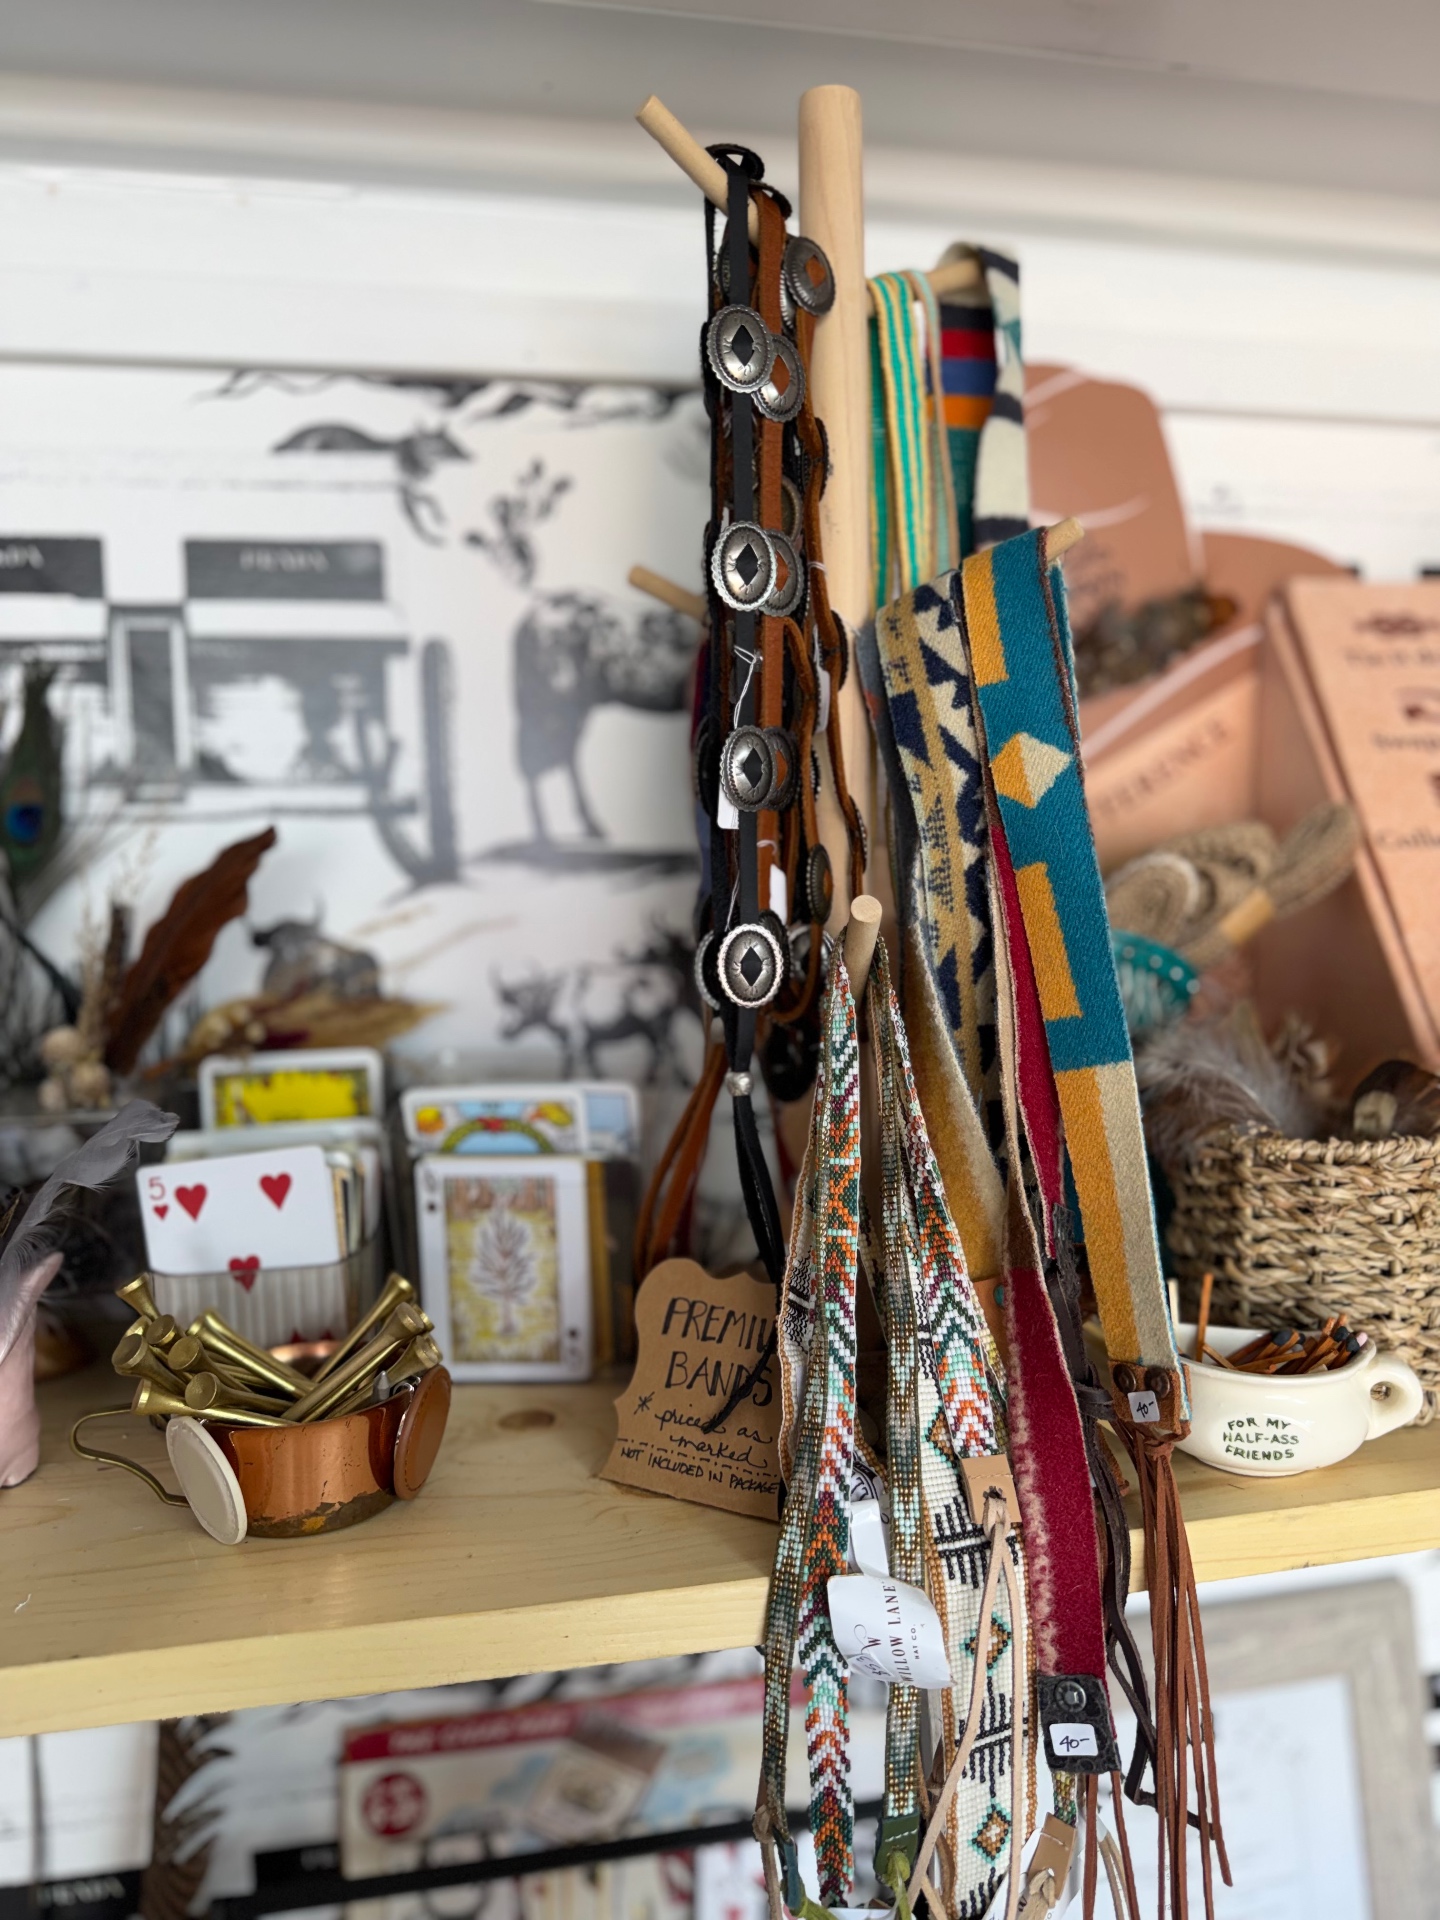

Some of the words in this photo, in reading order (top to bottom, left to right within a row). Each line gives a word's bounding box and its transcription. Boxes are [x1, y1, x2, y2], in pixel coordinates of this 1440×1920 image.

[149, 1176, 166, 1200] 5
[661, 1297, 778, 1353] PREMIU
[665, 1351, 773, 1407] BANDS
[736, 1426, 773, 1444] as
[1222, 1431, 1299, 1445] HALF-ASS
[1227, 1417, 1260, 1431] FOR
[1266, 1418, 1291, 1429] MY
[669, 1435, 768, 1469] marked
[1225, 1444, 1295, 1460] FRIENDS
[620, 1447, 645, 1462] NOT
[647, 1452, 704, 1478] INCLUDED
[708, 1470, 723, 1482] IN
[729, 1473, 780, 1495] PACKAGE
[883, 1585, 902, 1625] LANE
[888, 1635, 915, 1682] WILLOW
[912, 1645, 920, 1660] HAT
